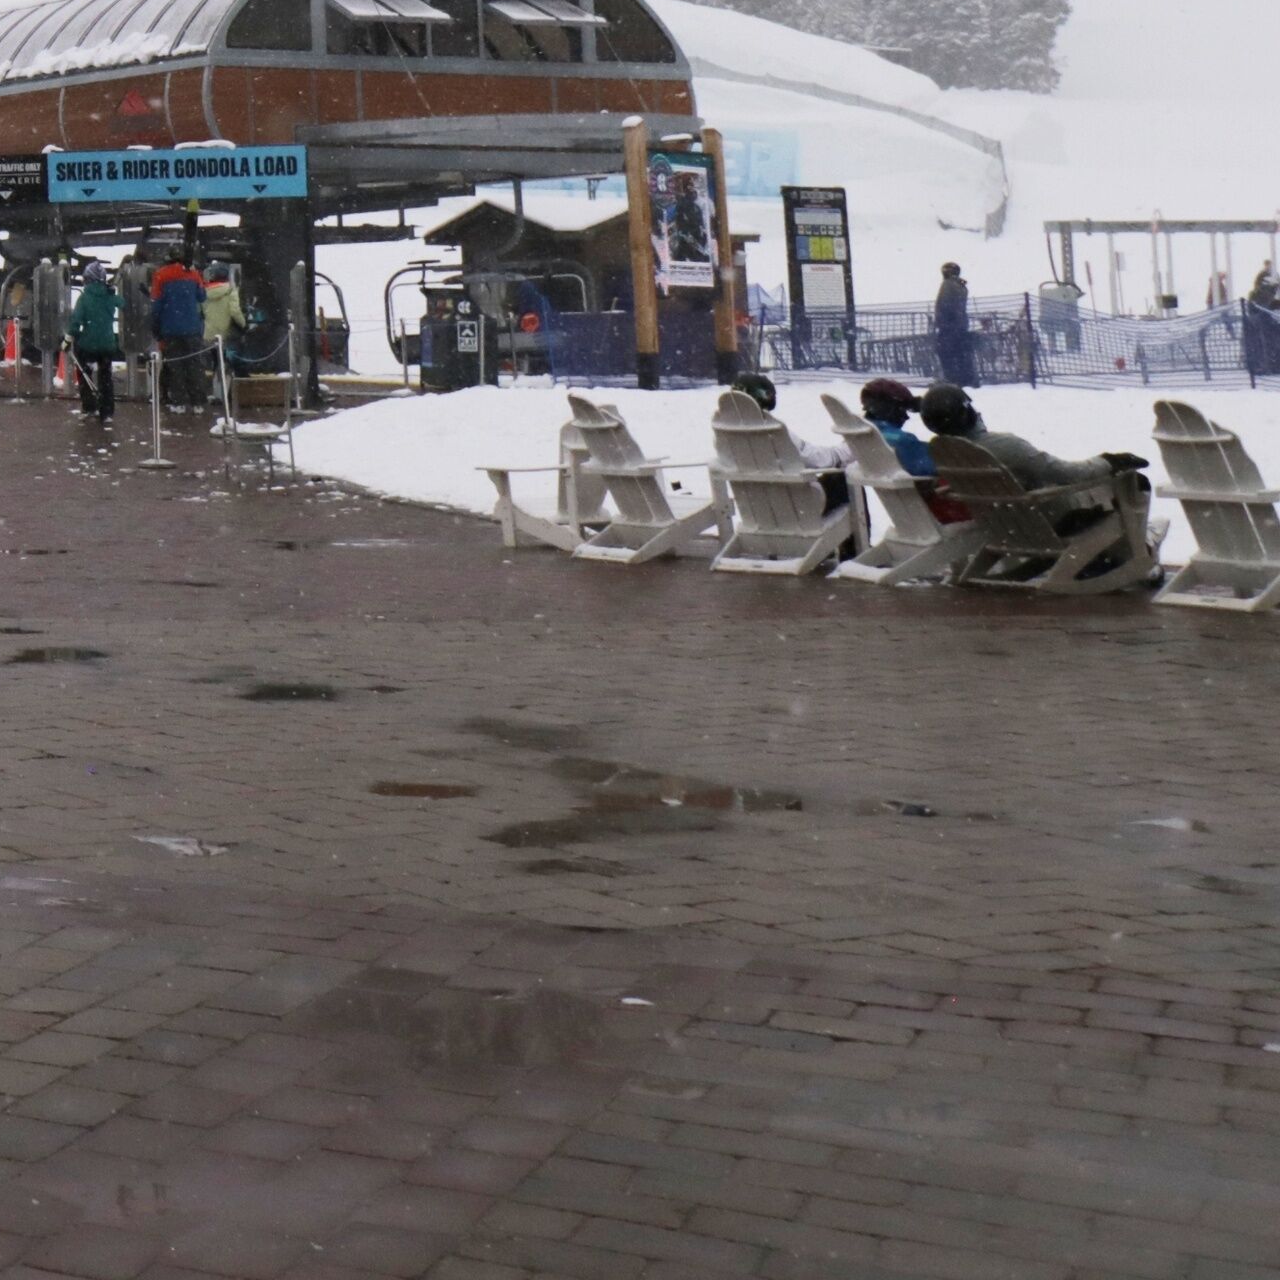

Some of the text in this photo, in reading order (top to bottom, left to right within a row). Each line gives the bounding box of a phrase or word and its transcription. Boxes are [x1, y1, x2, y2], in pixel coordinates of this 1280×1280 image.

[25, 162, 41, 171] ONLY
[56, 155, 298, 182] SKIER & RIDER GONDOLA LOAD
